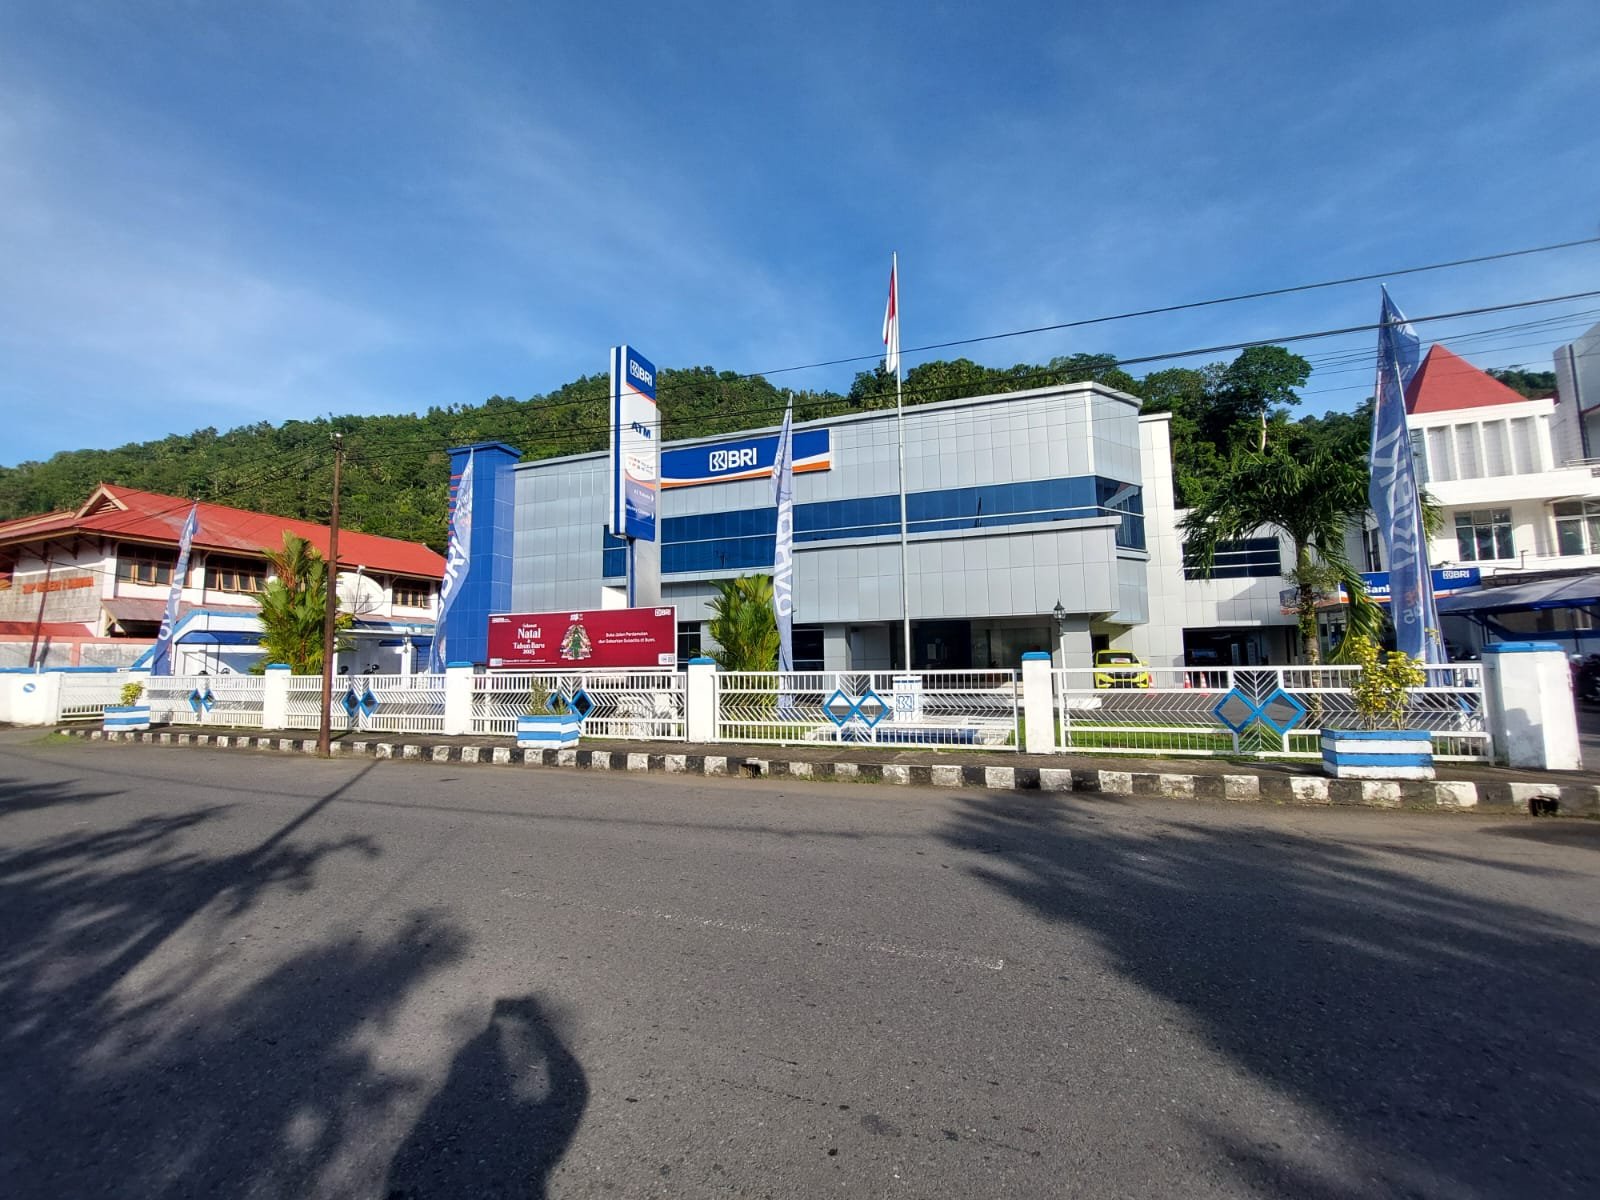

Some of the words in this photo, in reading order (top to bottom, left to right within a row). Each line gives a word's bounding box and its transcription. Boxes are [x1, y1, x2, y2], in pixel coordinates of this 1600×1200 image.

[639, 367, 653, 387] BRI
[631, 421, 651, 439] ATM
[728, 447, 757, 468] BRI
[1453, 570, 1469, 579] BRI
[517, 627, 541, 639] Natal
